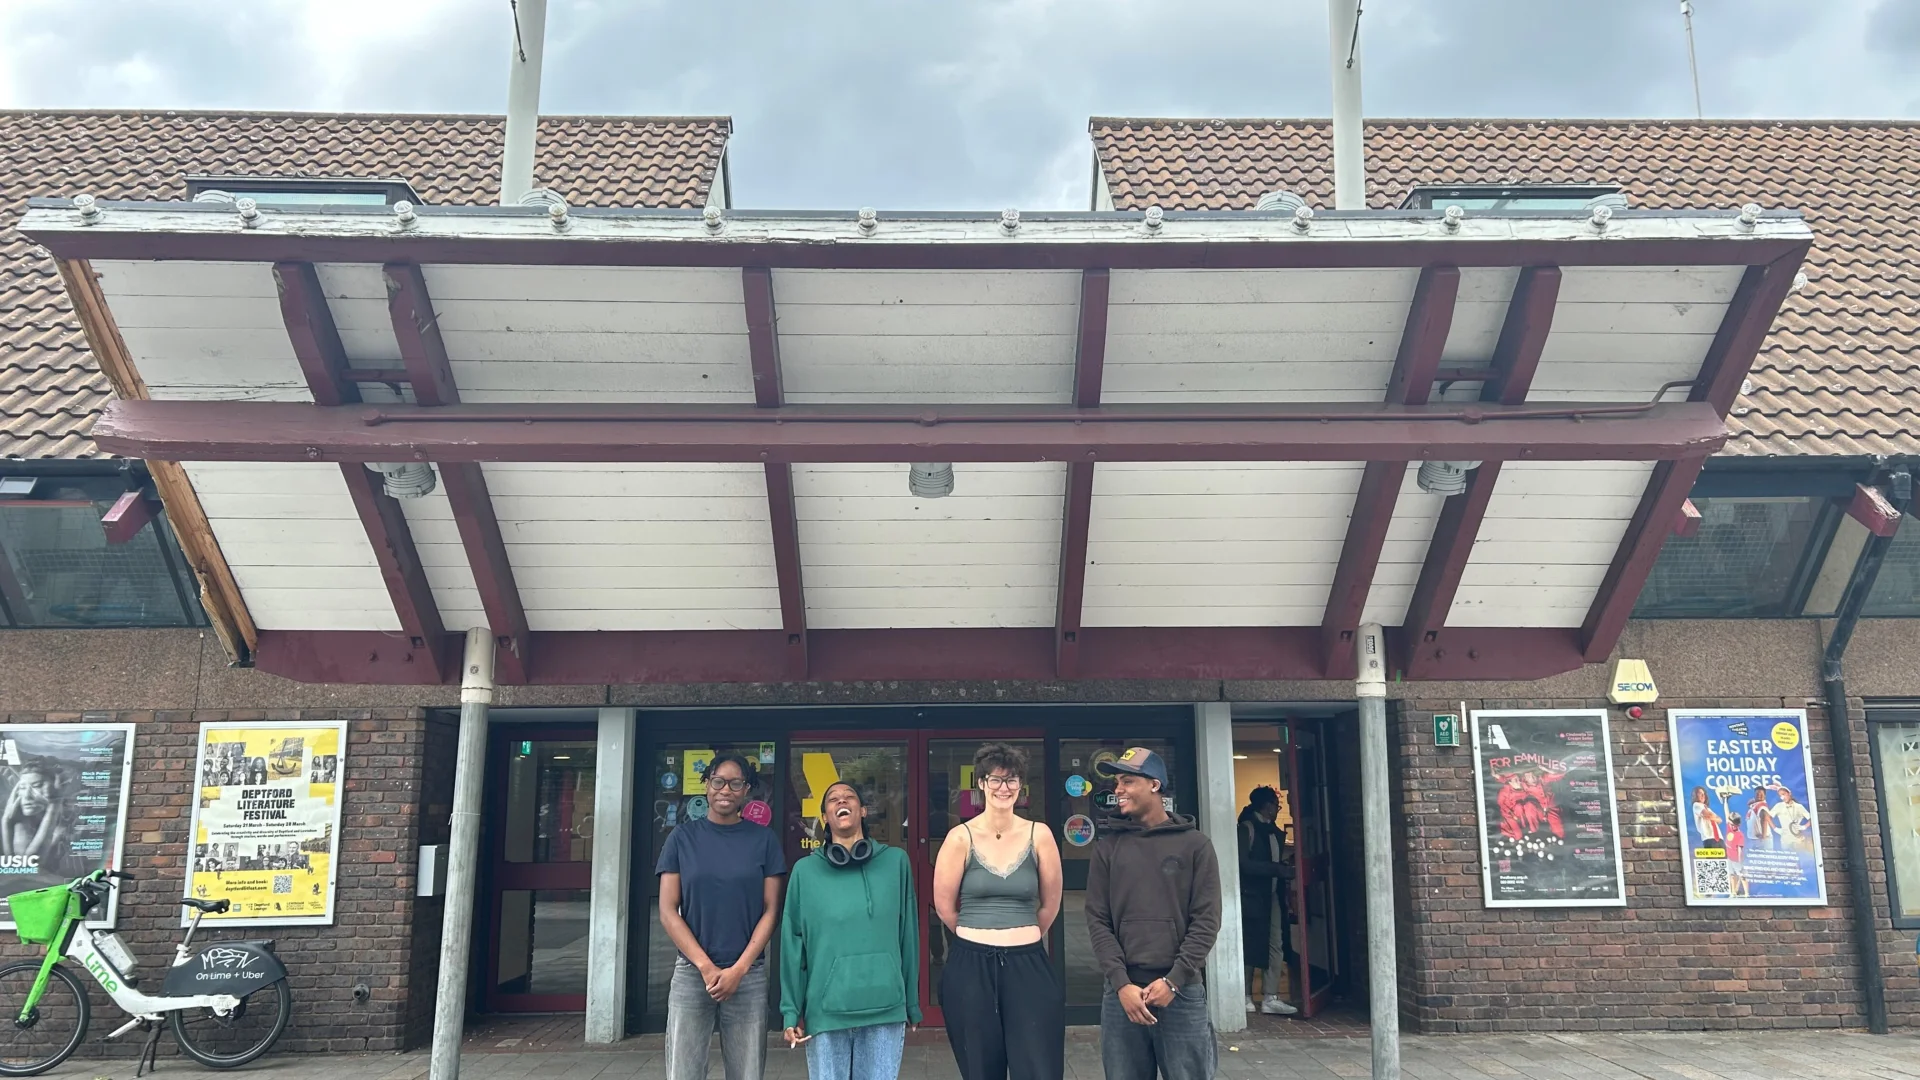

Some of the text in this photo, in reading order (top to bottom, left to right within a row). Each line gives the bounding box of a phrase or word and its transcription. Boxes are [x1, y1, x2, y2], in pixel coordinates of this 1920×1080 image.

[1618, 682, 1652, 691] SECOM
[1708, 740, 1773, 754] EASTER
[1489, 753, 1567, 771] FOR FAMILIES
[1706, 757, 1777, 772] HOLIDAY
[1706, 775, 1782, 789] COURSES
[242, 788, 292, 799] DEPTFORD
[237, 799, 295, 810] LITERATURE
[244, 810, 287, 820] FESTIVAL
[801, 838, 820, 849] the
[0, 855, 39, 867] USIC
[85, 952, 118, 993] Lime
[210, 972, 232, 980] Lime
[242, 970, 264, 979] Uber
